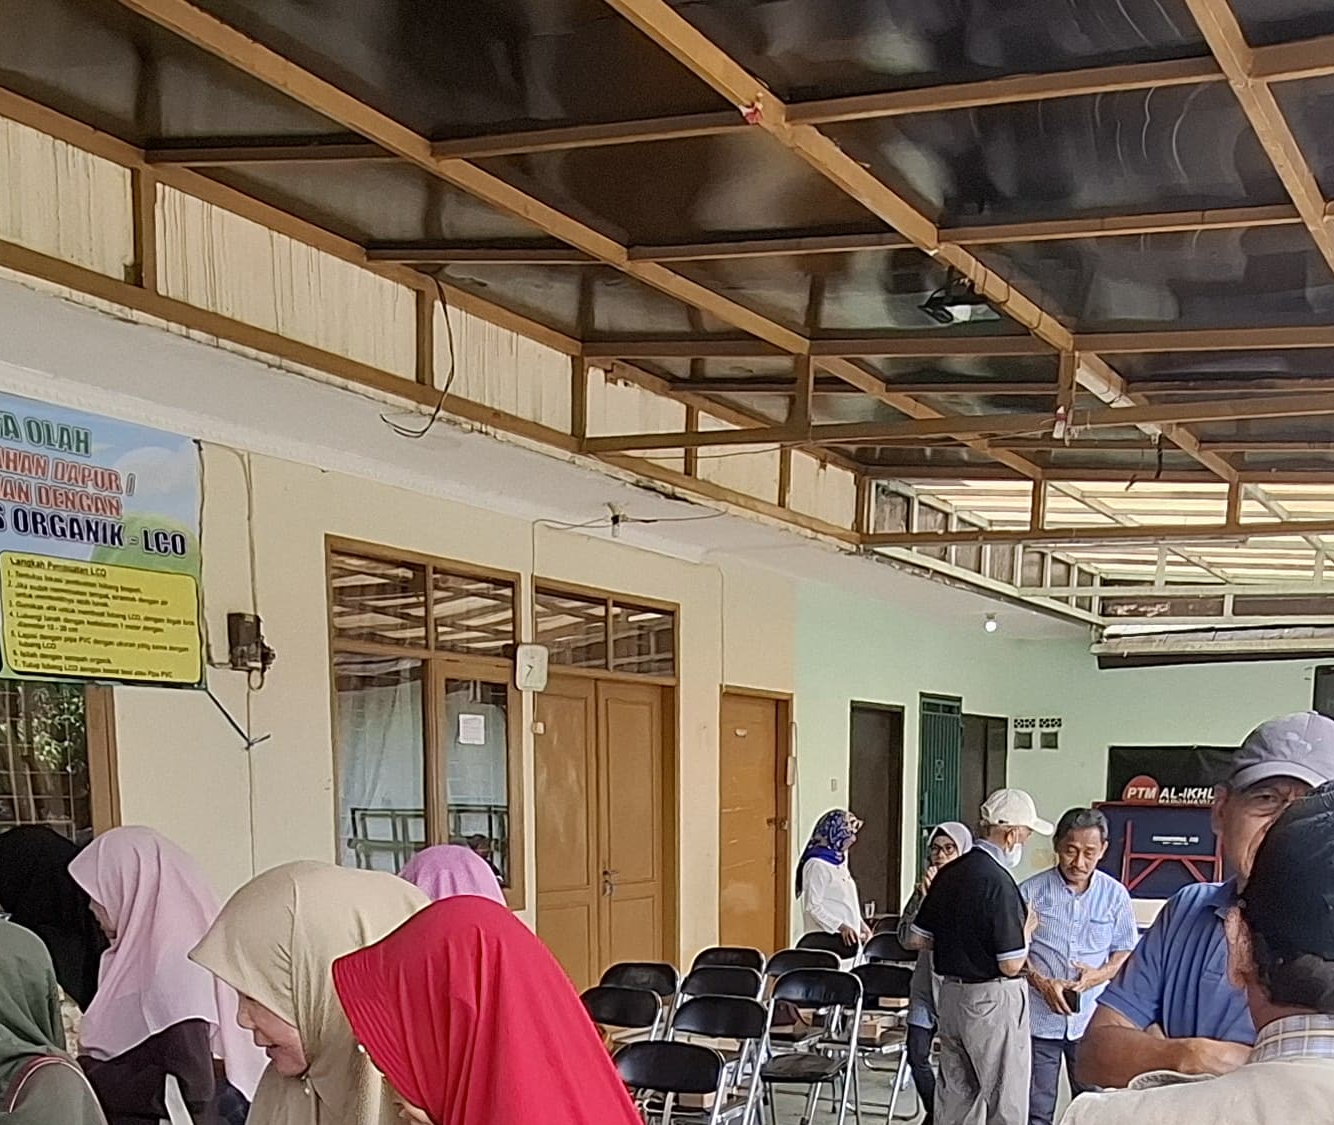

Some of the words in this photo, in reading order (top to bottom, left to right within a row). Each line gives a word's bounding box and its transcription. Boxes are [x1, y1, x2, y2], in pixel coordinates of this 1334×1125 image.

[25, 418, 91, 456] OLAH
[51, 459, 123, 495] DAPUR
[36, 483, 123, 519] DENGAN
[11, 506, 125, 549] ORGANIK
[141, 527, 187, 558] LCO
[1127, 787, 1157, 799] PTM
[1159, 787, 1215, 800] AL-IKHL
